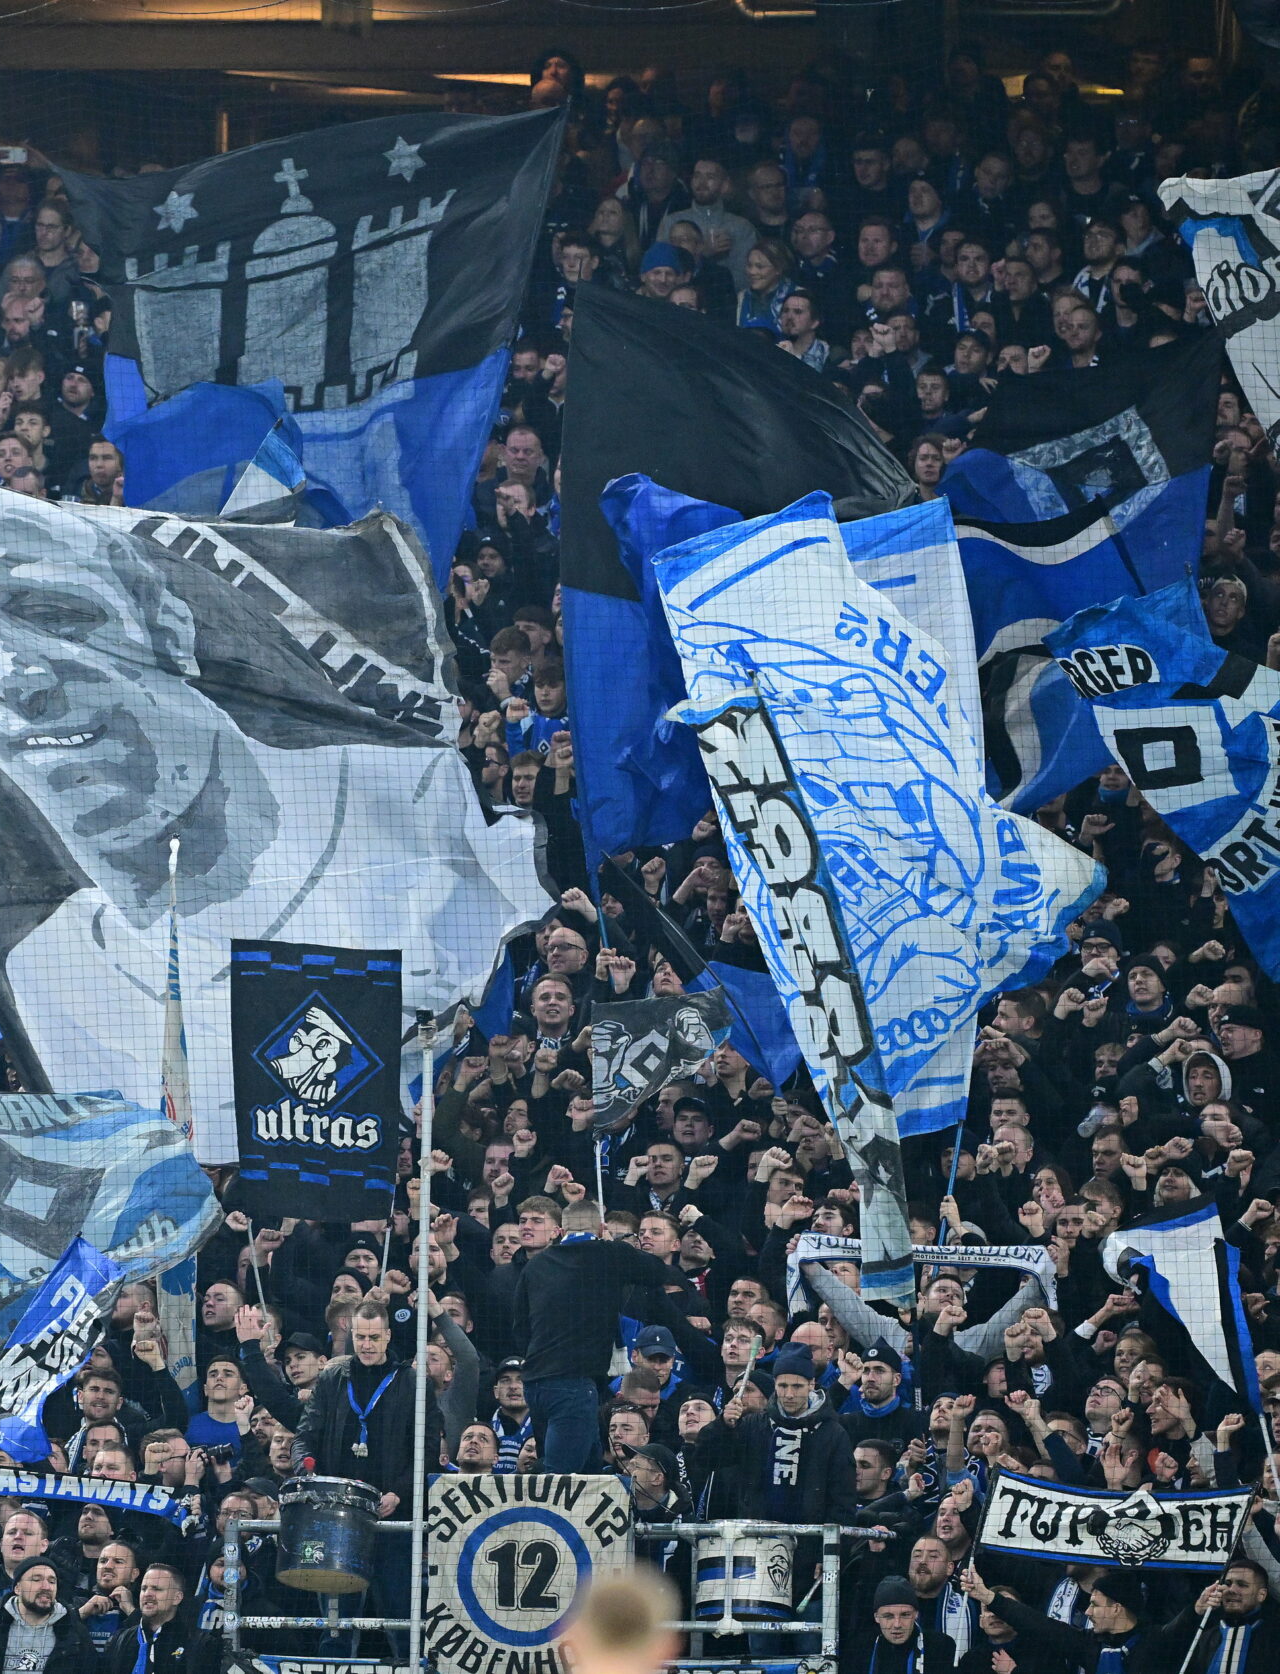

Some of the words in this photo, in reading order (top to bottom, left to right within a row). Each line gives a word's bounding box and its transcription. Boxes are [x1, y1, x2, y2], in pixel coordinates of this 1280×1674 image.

[255, 1099, 379, 1149] ultras
[585, 1491, 632, 1549] 12
[485, 1539, 559, 1612] 12
[424, 1602, 562, 1674] KØBENH
